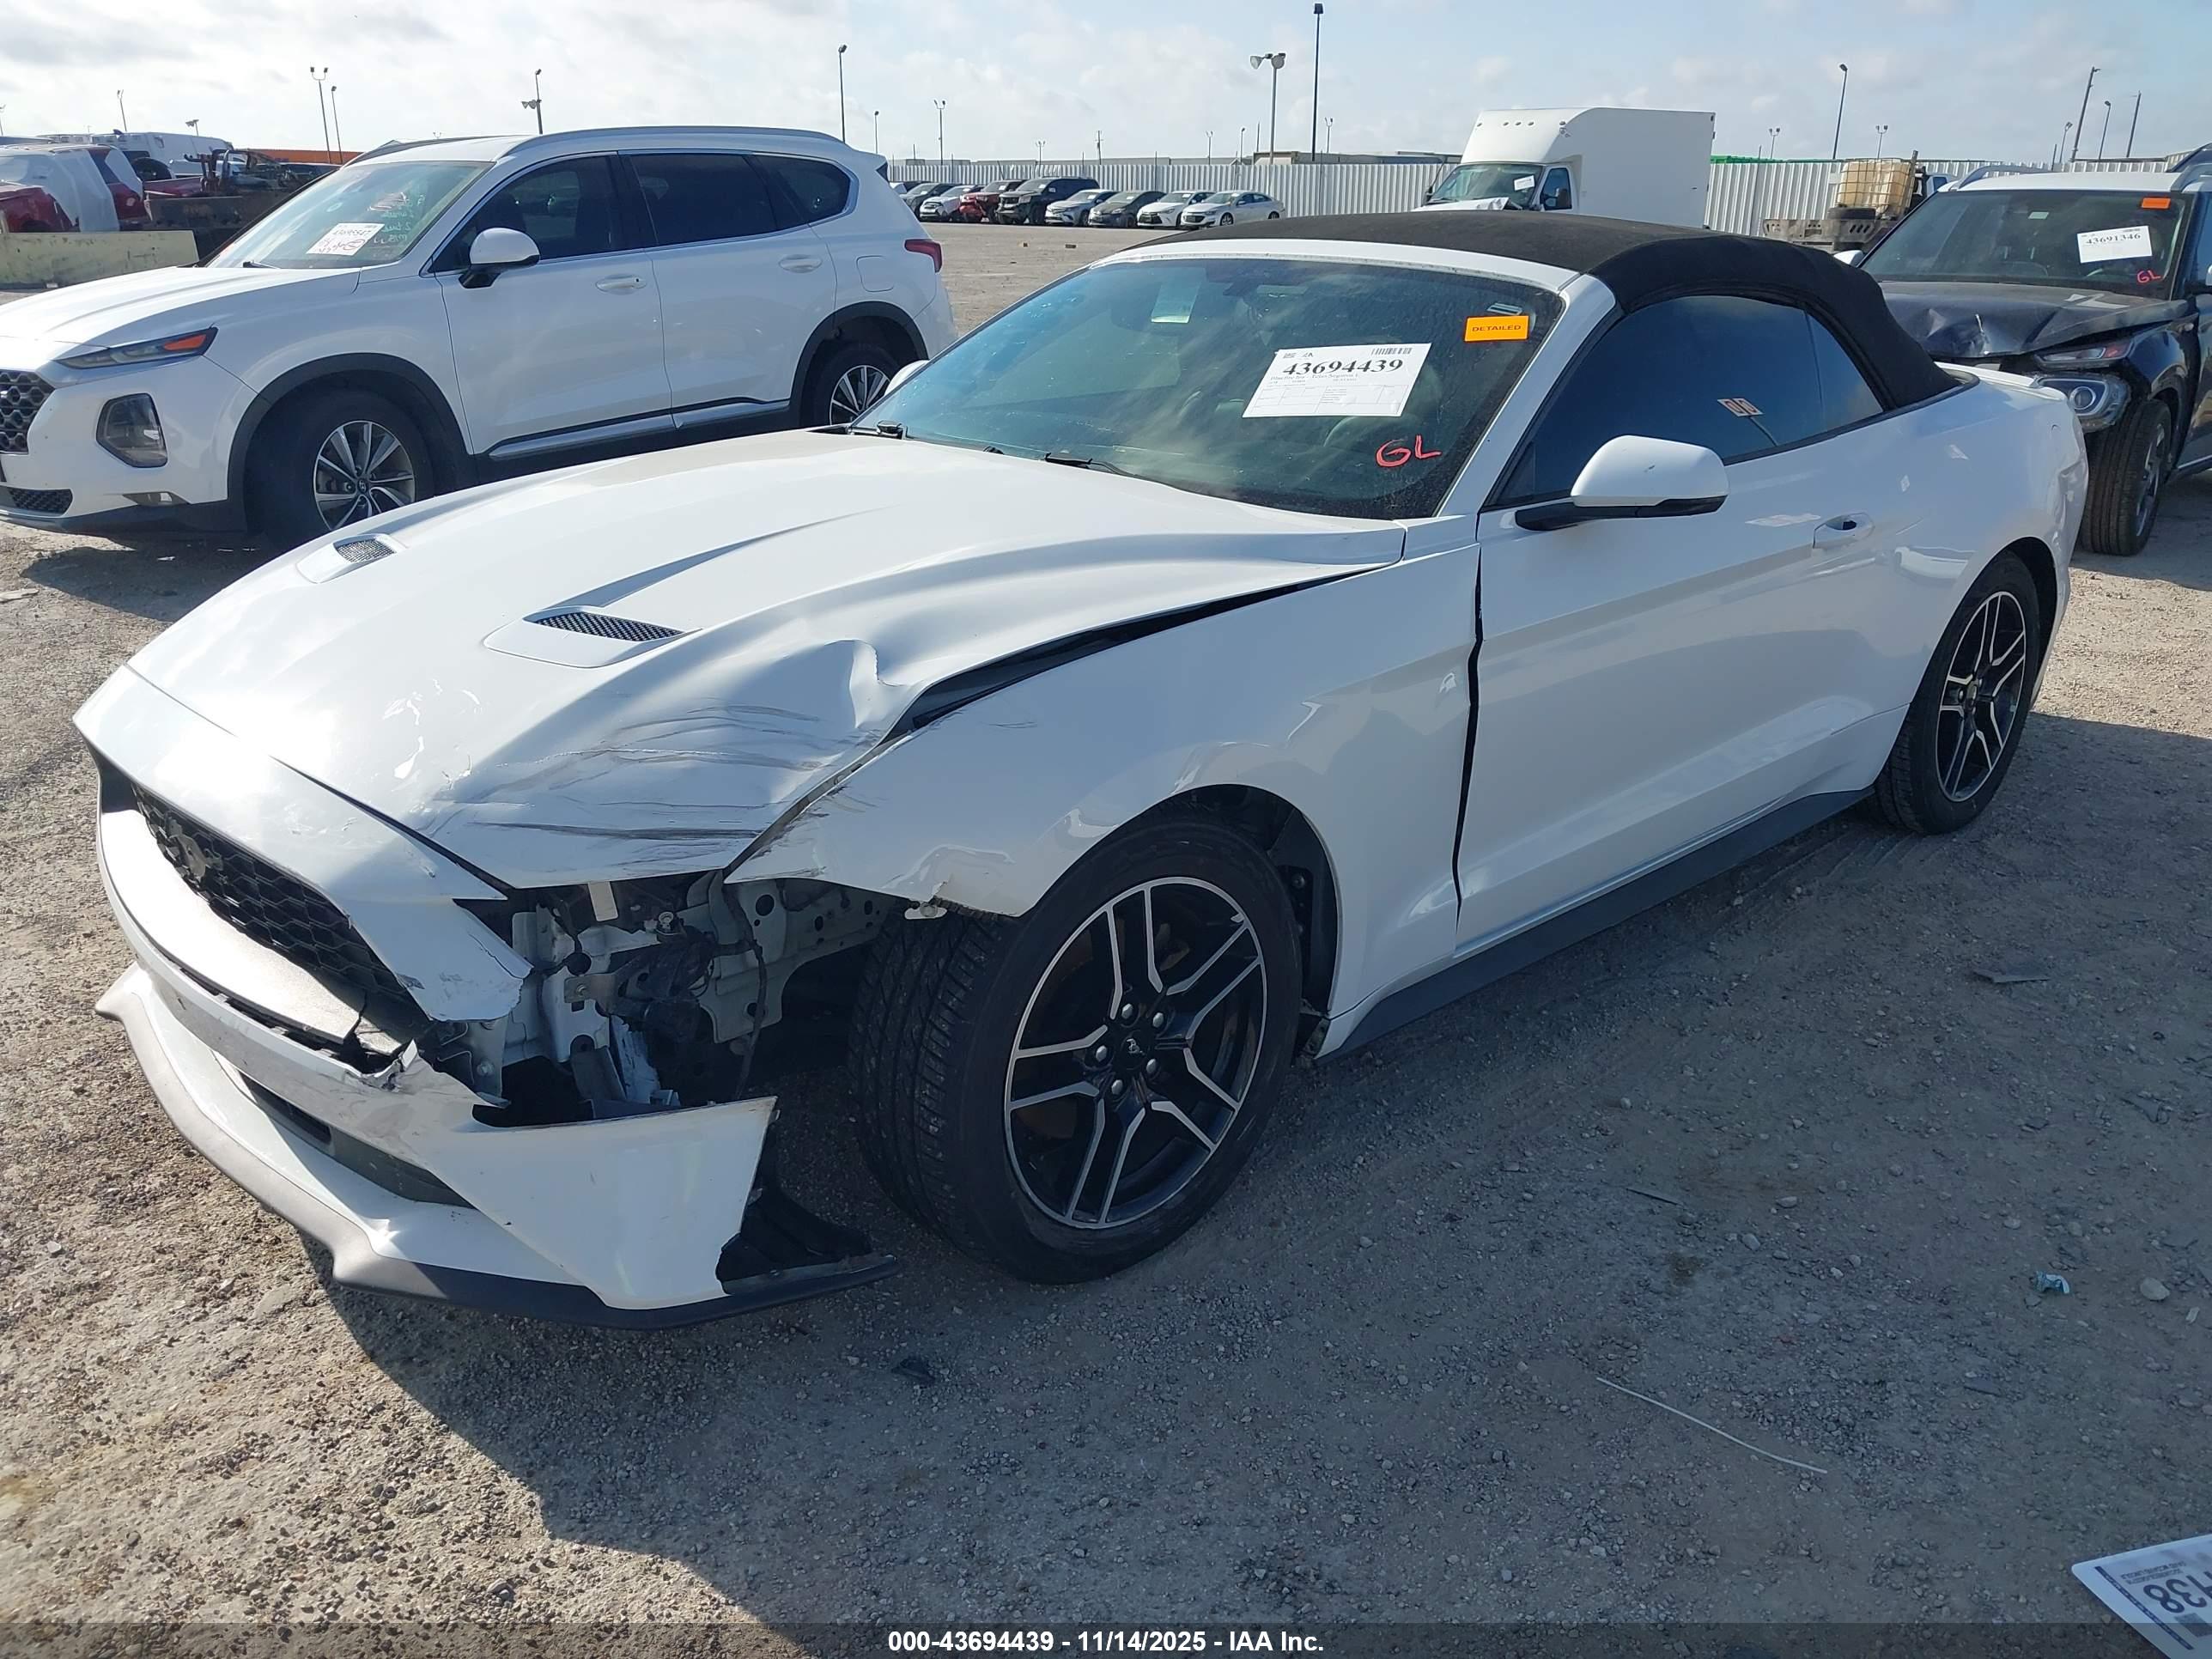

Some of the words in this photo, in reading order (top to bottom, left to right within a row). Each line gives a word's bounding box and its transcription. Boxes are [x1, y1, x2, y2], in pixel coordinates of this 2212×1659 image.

[2085, 233, 2142, 245] 43691346
[2136, 269, 2161, 283] GL
[1282, 359, 1404, 375] 43694439
[1376, 434, 1443, 467] GL
